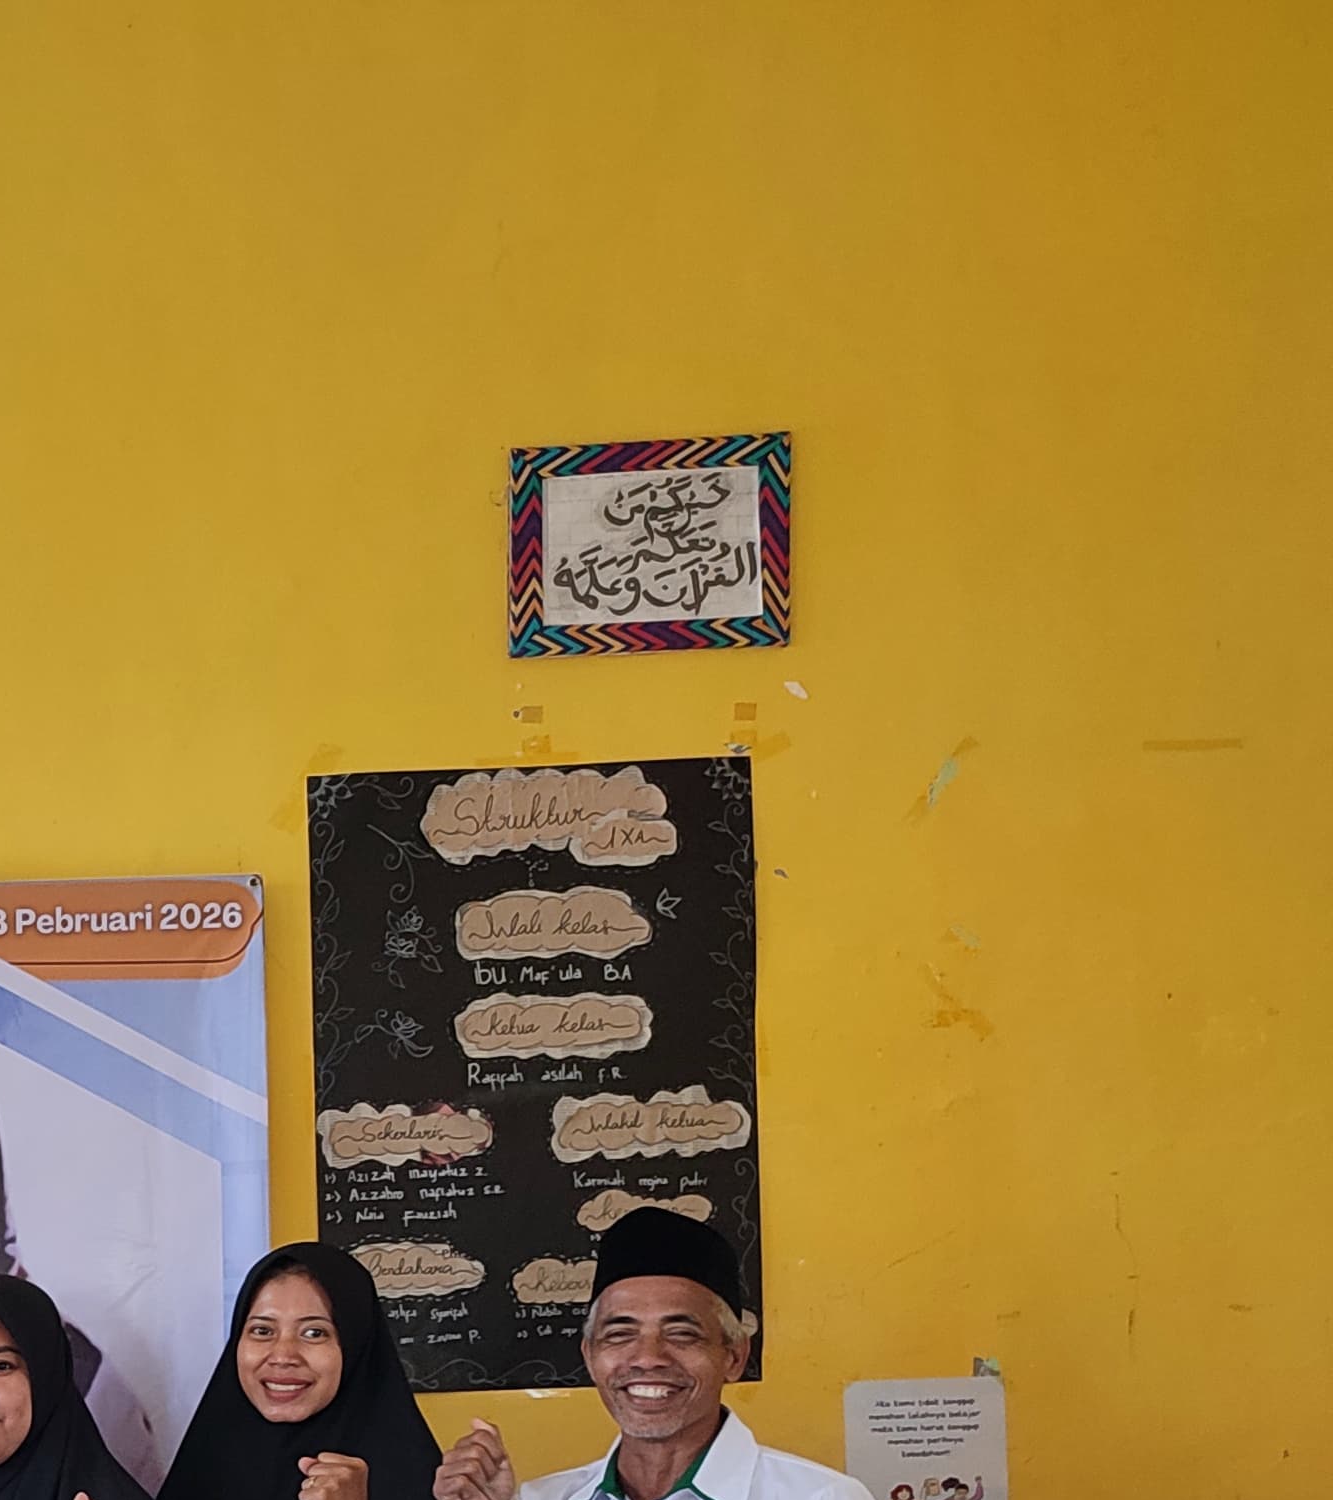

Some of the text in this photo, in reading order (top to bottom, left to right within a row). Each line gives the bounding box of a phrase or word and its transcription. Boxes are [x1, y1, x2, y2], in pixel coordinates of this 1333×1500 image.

[441, 793, 597, 836] Struktur
[15, 903, 153, 935] Pebruari
[159, 901, 243, 931] 2026
